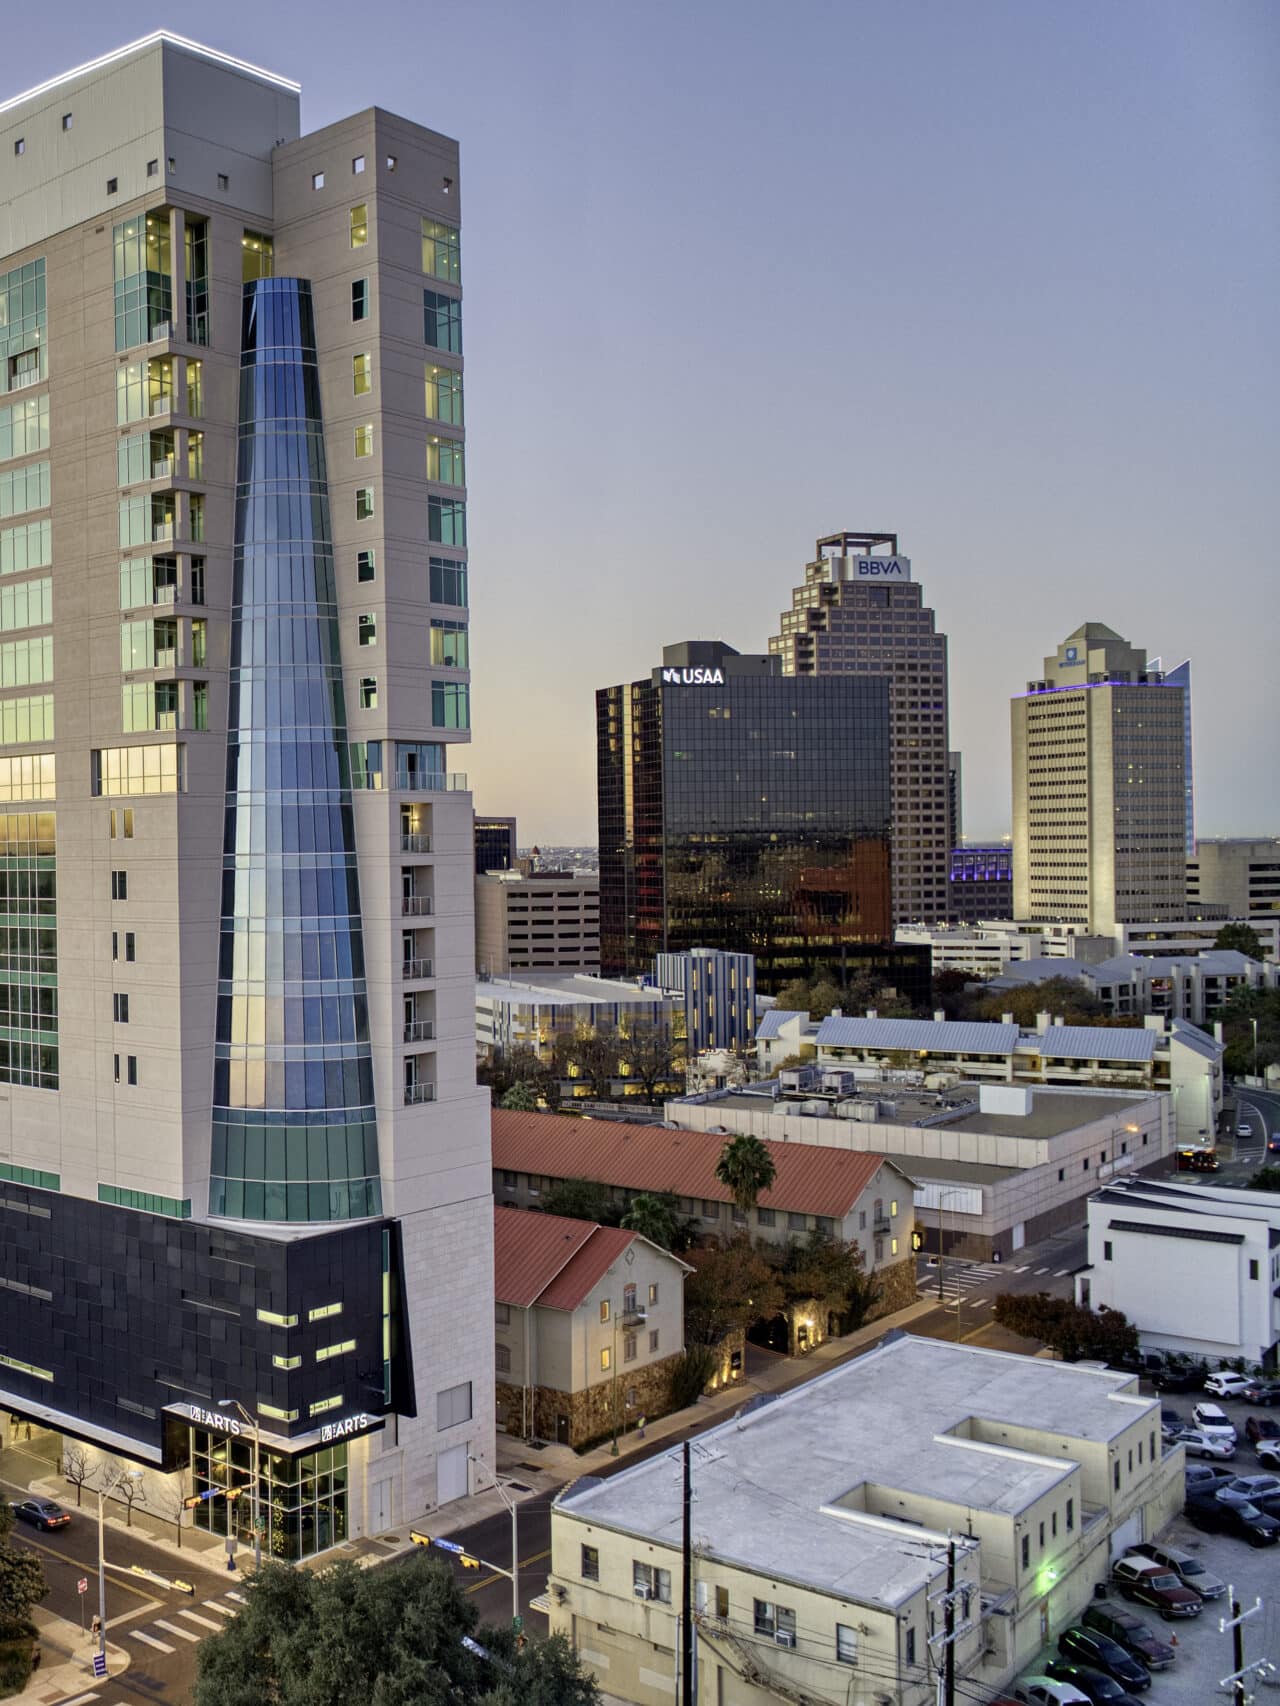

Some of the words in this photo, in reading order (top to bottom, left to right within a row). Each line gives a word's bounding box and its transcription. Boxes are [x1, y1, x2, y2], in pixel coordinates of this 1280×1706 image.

[859, 561, 901, 575] BBVA
[683, 668, 724, 684] USAA
[205, 1411, 240, 1435] ARTS
[335, 1413, 368, 1437] ARTS
